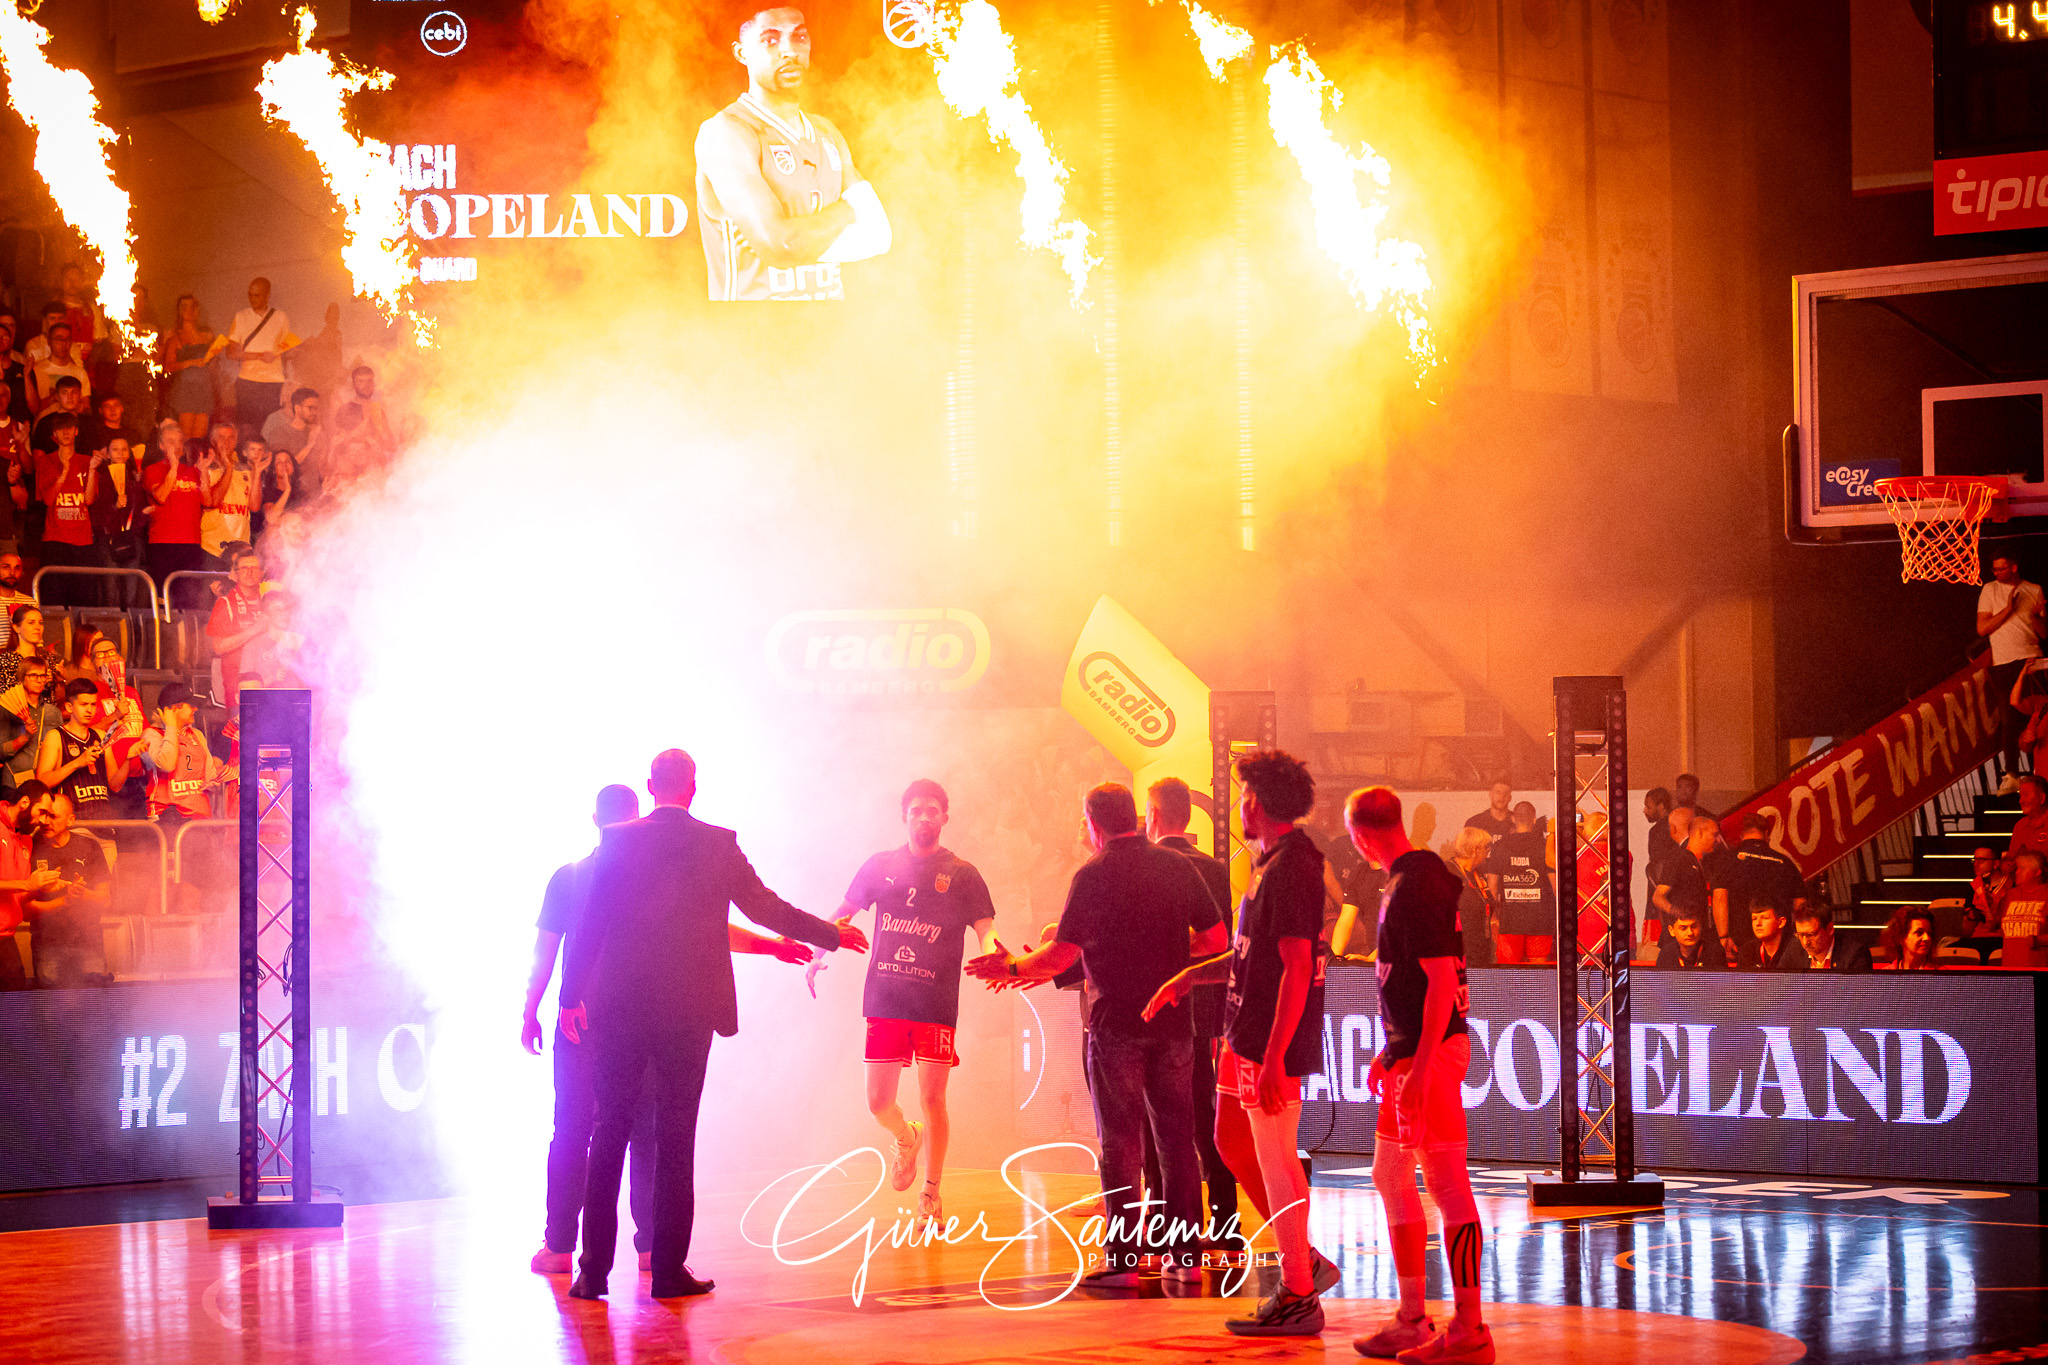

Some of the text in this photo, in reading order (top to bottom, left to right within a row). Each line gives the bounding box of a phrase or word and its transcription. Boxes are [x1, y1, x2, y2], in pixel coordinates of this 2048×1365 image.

[400, 193, 689, 240] OPELAND
[803, 622, 964, 669] radio
[1088, 690, 1136, 735] BAMBERG
[1092, 670, 1162, 734] radio
[906, 886, 917, 908] 2
[1503, 874, 1535, 884] BMA365
[881, 912, 943, 945] Bamberg
[877, 961, 936, 980] DATOLUTION
[119, 1034, 188, 1130] #2
